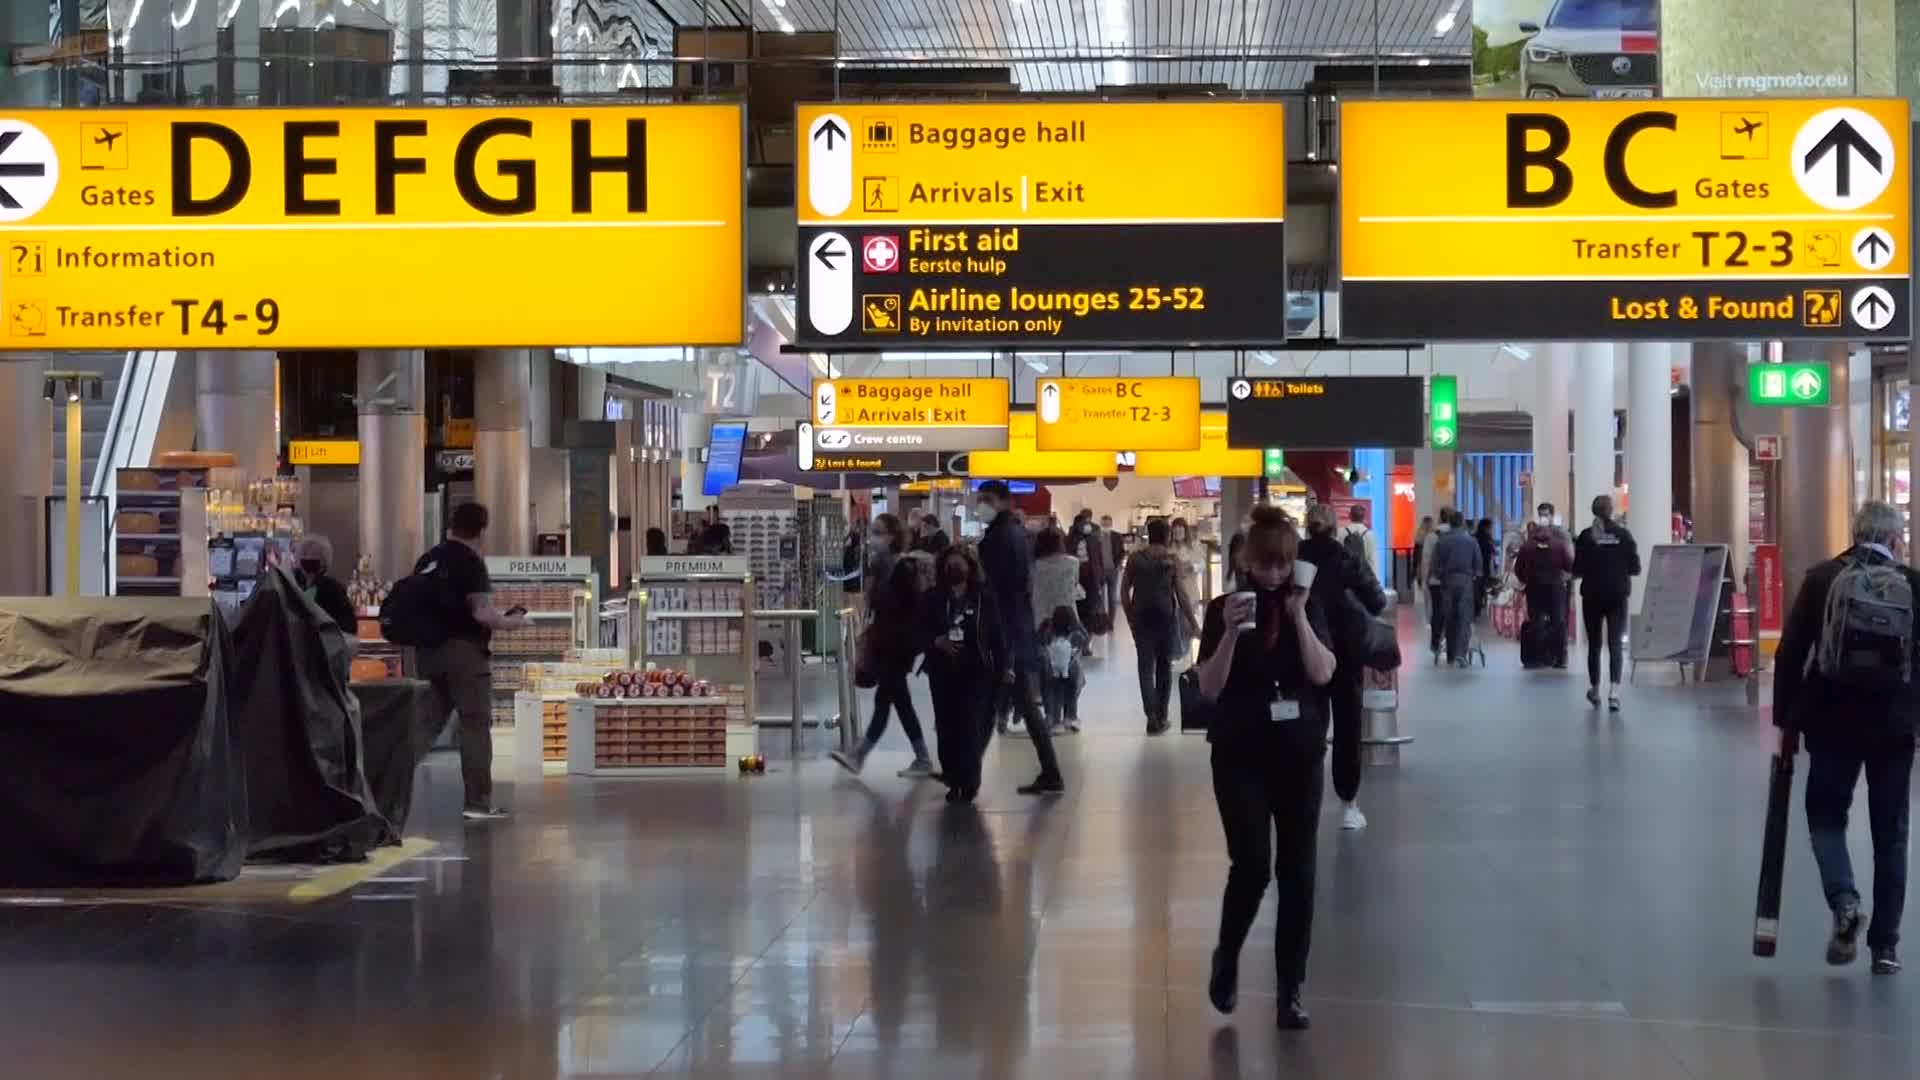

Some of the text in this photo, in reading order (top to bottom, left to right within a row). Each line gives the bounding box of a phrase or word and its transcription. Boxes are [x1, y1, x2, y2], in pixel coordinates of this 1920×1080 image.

[1696, 72, 1848, 92] Visit mgmotor.eu
[909, 120, 1085, 149] Baggage hall
[1507, 111, 1770, 208] B C Gates
[81, 186, 155, 207] Gates
[909, 181, 1084, 204] Arrivals Exit
[909, 229, 1019, 252] First aid
[1573, 231, 1794, 267] Transfer T2-3
[56, 246, 216, 269] Information
[909, 257, 1007, 275] Eerste hulp
[909, 288, 1205, 316] Airline lounges 25-52
[1611, 296, 1794, 320] Lost & Found
[56, 298, 280, 336] Transfer T4-9
[909, 317, 1063, 335] By invitation only
[857, 383, 972, 402] Baggage hall
[1286, 383, 1324, 395] Toilets
[857, 408, 967, 422] Arrivals Exit
[1129, 406, 1172, 422] T2-3
[509, 560, 568, 573] PREMIUM
[665, 560, 724, 573] PREMIUM
